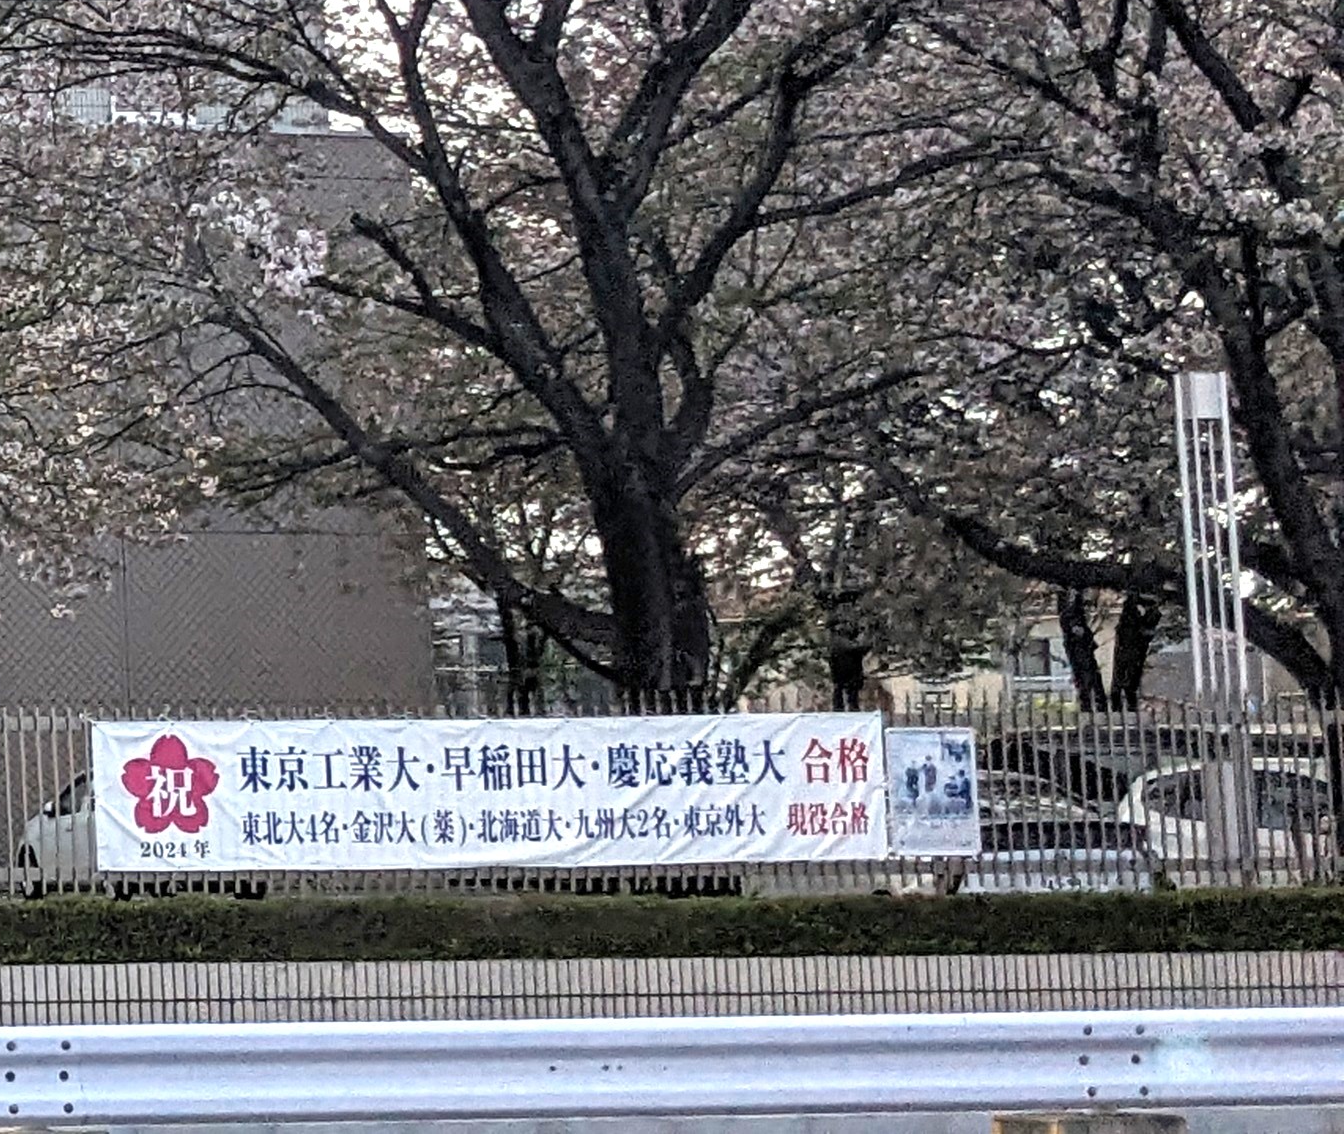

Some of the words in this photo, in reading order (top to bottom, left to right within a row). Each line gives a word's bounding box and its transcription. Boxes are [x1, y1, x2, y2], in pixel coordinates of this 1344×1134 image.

[144, 765, 198, 818] 祝
[236, 738, 786, 793] 東京工業大・早稲田大・慶応義塾大
[801, 737, 869, 784] 合格
[786, 801, 870, 837] 現役合格
